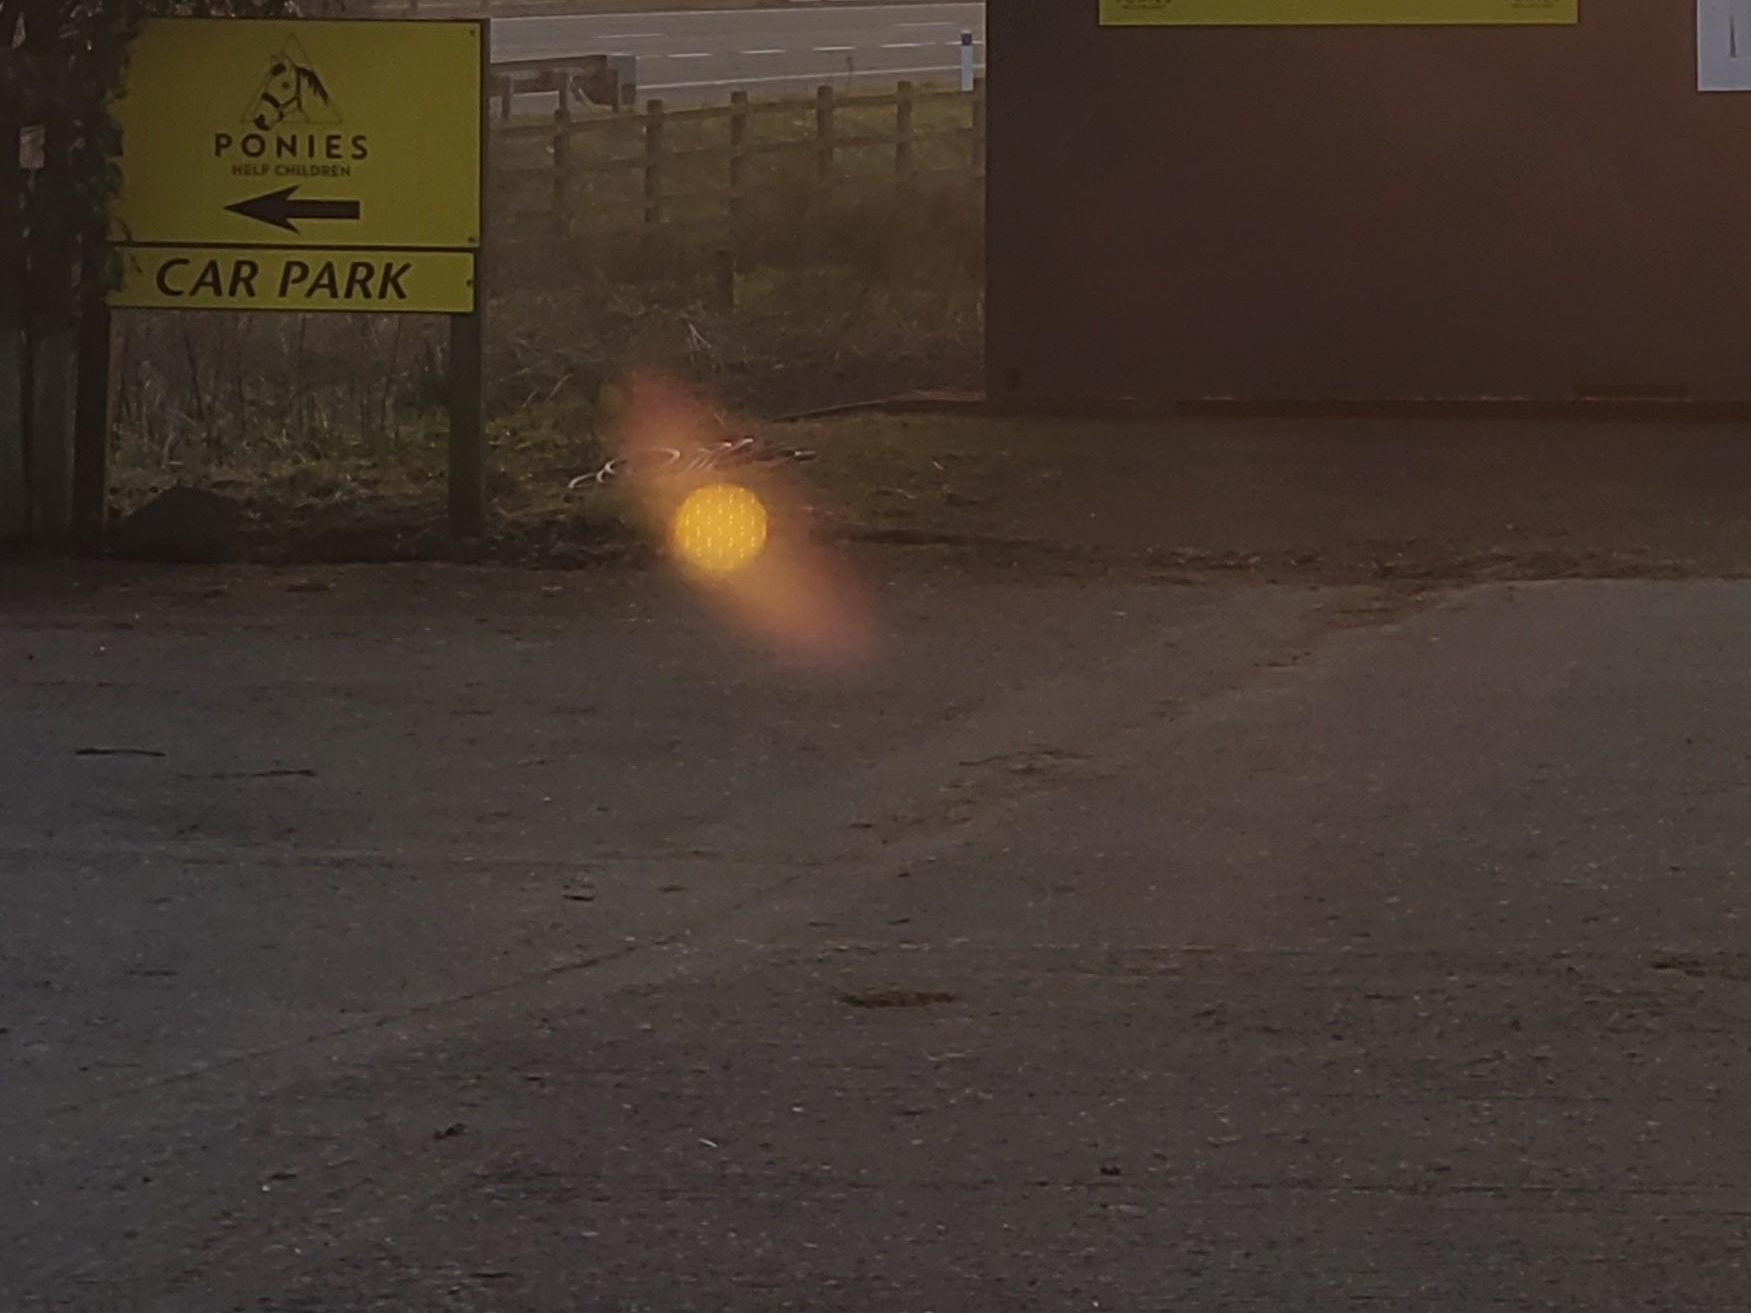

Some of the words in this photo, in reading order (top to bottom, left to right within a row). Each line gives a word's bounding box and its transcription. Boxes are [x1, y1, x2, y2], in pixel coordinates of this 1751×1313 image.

[214, 132, 369, 160] PONIES
[231, 163, 270, 177] HELP
[274, 163, 352, 178] CHILDREN
[155, 257, 261, 298] CAR
[277, 259, 413, 300] PARK
